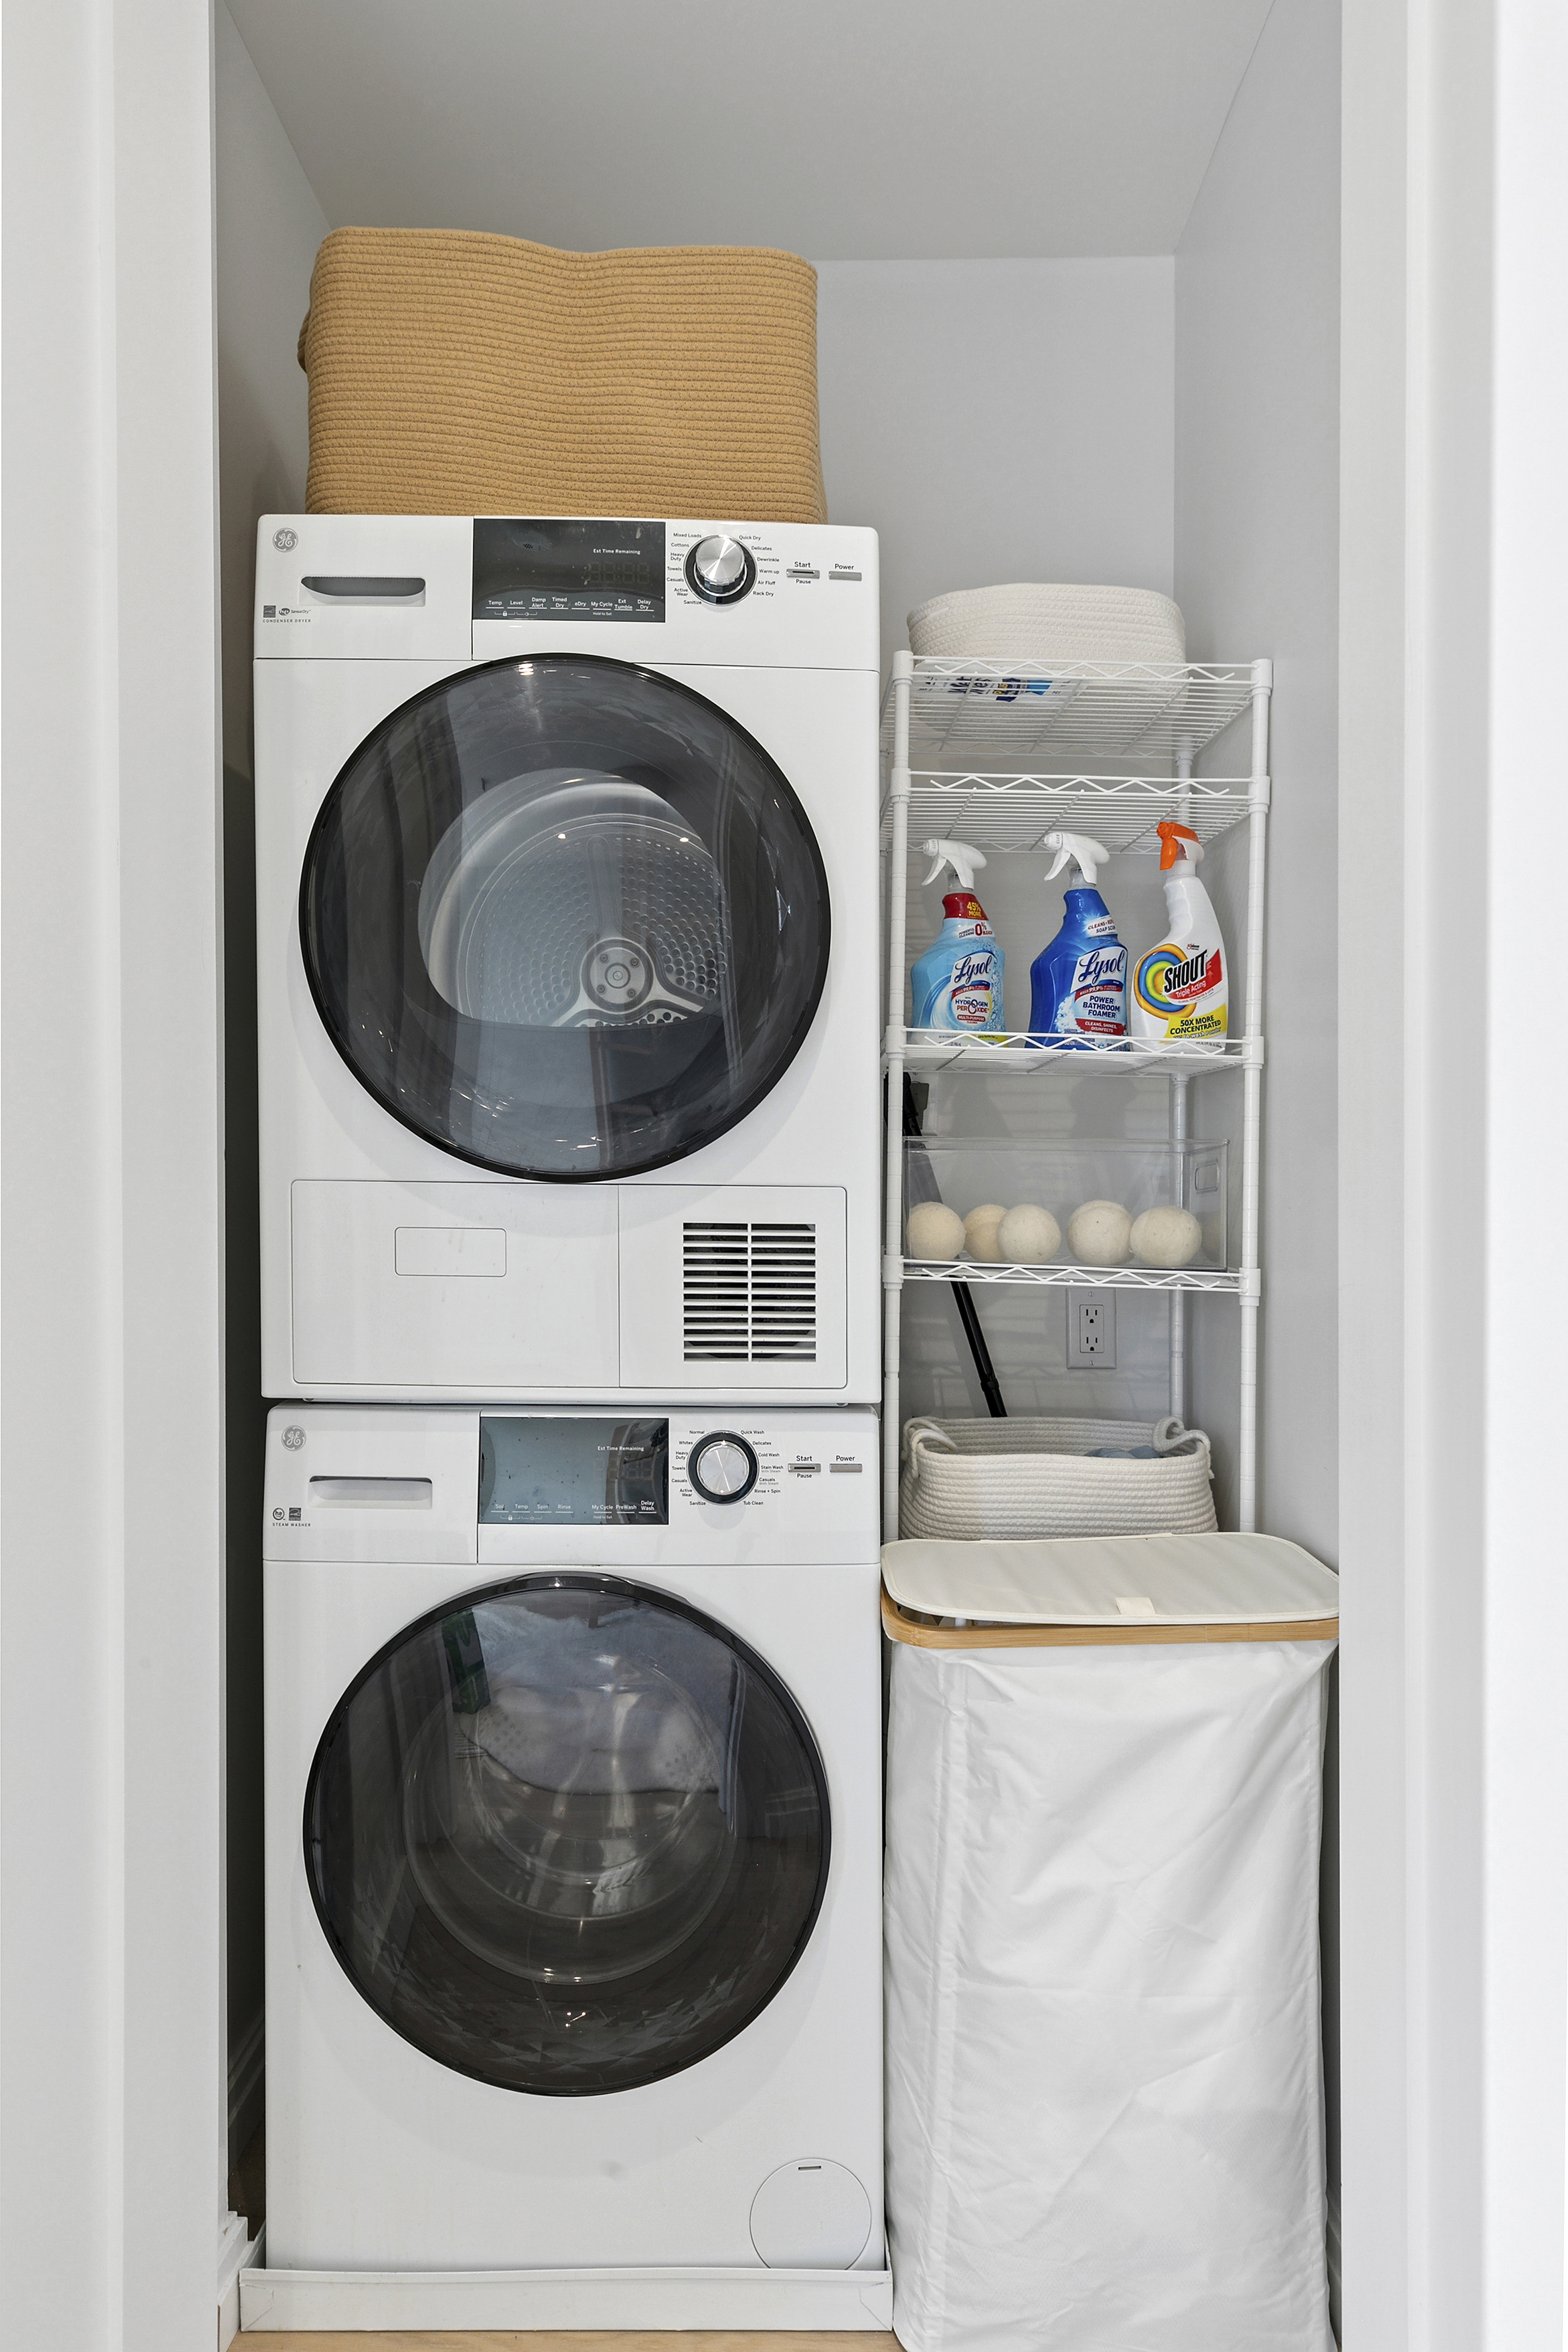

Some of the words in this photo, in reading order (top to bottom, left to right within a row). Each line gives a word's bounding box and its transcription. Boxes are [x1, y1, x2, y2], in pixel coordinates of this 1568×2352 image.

[967, 902, 981, 911] 45%
[975, 922, 987, 936] 0%
[1088, 921, 1105, 930] CLEANS
[954, 955, 991, 984] Lysol
[1078, 950, 1124, 984] Lysol
[1164, 949, 1207, 993] SHOUT
[1175, 988, 1190, 998] Triple
[1191, 981, 1206, 992] Acting
[955, 999, 988, 1008] HYDROGEN
[1090, 996, 1114, 1004] POWER
[957, 1004, 988, 1014] PEROXIDE
[1083, 1002, 1120, 1012] BATHROOM
[1088, 1009, 1116, 1018] FOAMER
[1195, 1015, 1214, 1025] MORE
[1170, 1020, 1221, 1034] CONCENTRATED
